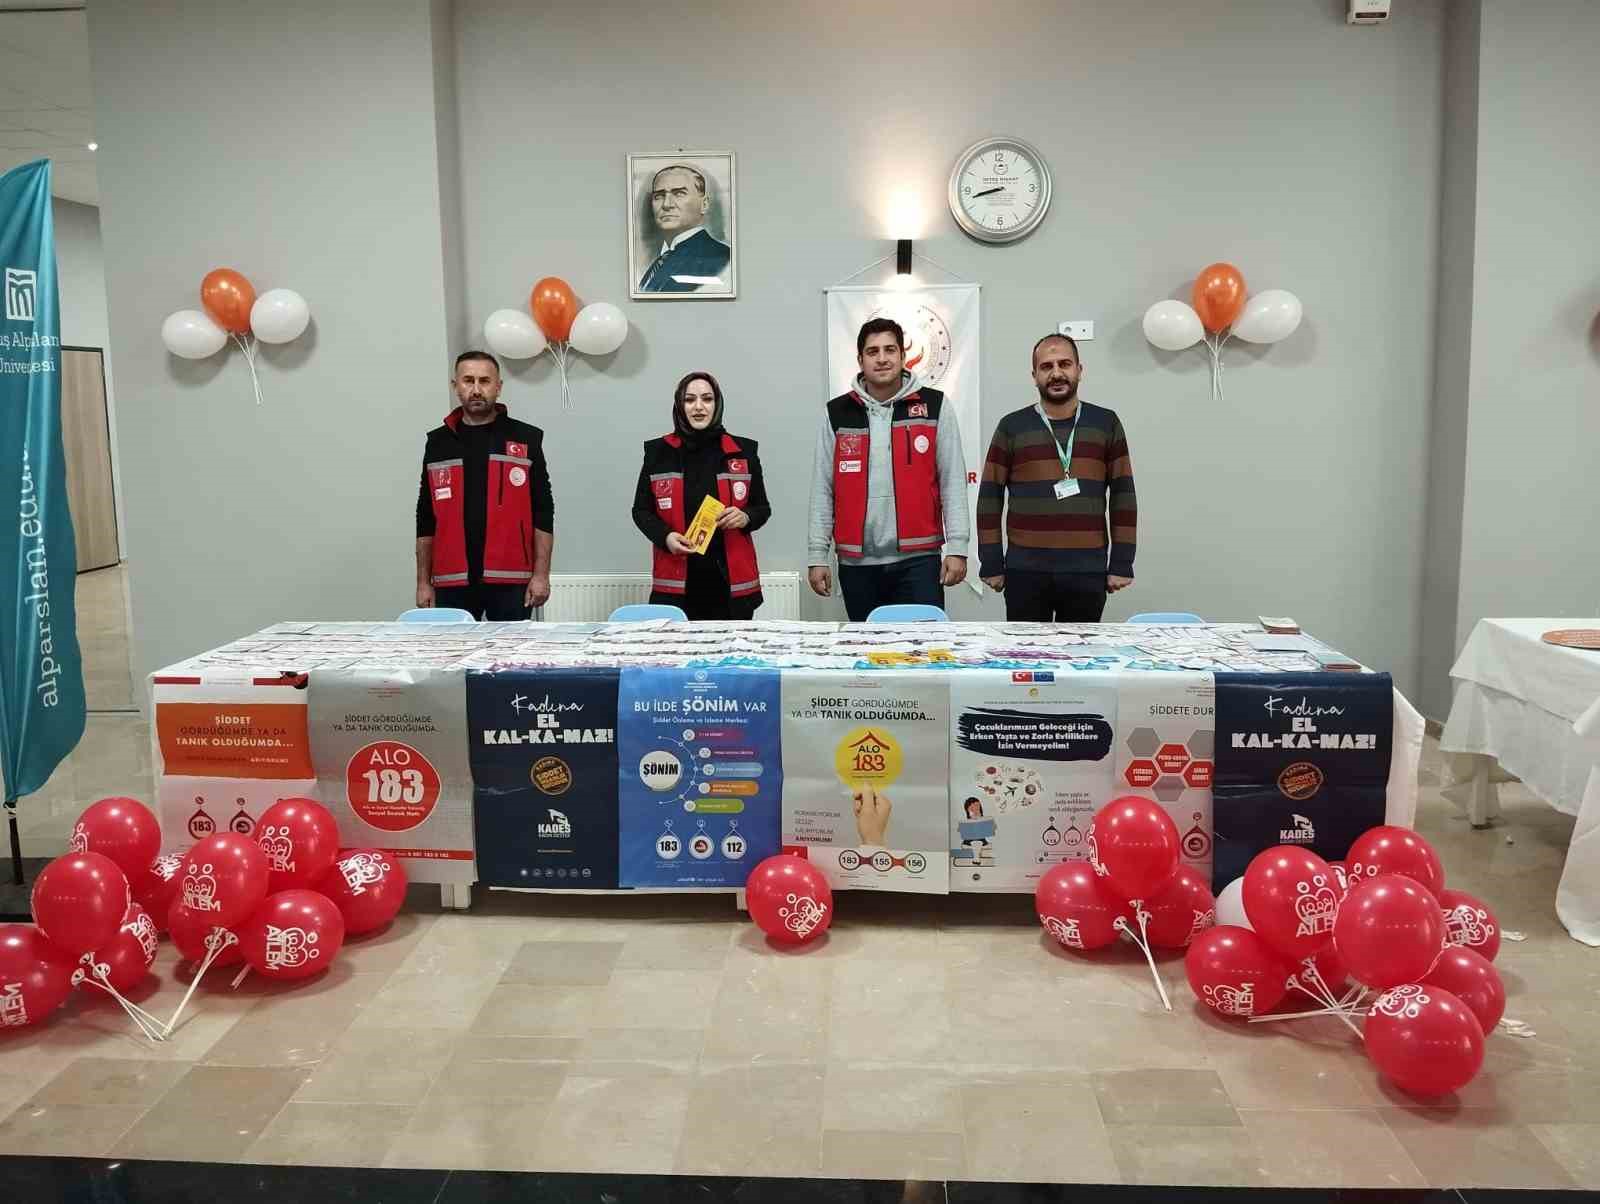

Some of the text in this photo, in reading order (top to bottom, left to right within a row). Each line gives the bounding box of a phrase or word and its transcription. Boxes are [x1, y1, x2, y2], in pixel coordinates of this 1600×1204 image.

[994, 153, 1004, 162] 12
[964, 186, 972, 196] 9
[1028, 183, 1036, 193] 3
[634, 695, 768, 716] BU İLDE ŞÖNİM VAR
[811, 697, 849, 708] ŞİDDET
[215, 714, 251, 726] ŞİDDET
[791, 709, 935, 721] YA DA TANIK OLDUĞUMDA...
[537, 714, 560, 728] EL
[1292, 717, 1317, 732] EL
[256, 728, 268, 736] YA
[272, 729, 288, 737] DA
[483, 729, 614, 745] KAL-KA-MAZ!
[969, 732, 994, 741] Erken
[995, 732, 1018, 742] Yaşta
[176, 738, 208, 747] TANIK
[1231, 733, 1377, 749] KAL-KA-MAZ!
[858, 745, 881, 753] ALO
[369, 749, 411, 766] ALO
[852, 753, 887, 771] 183
[362, 769, 425, 804] 183
[192, 821, 211, 832] 183
[538, 823, 571, 834] KADES
[1280, 829, 1315, 840] KADES
[659, 841, 678, 852] 183
[726, 842, 743, 853] 112
[841, 856, 858, 865] 183
[874, 857, 891, 866] 155
